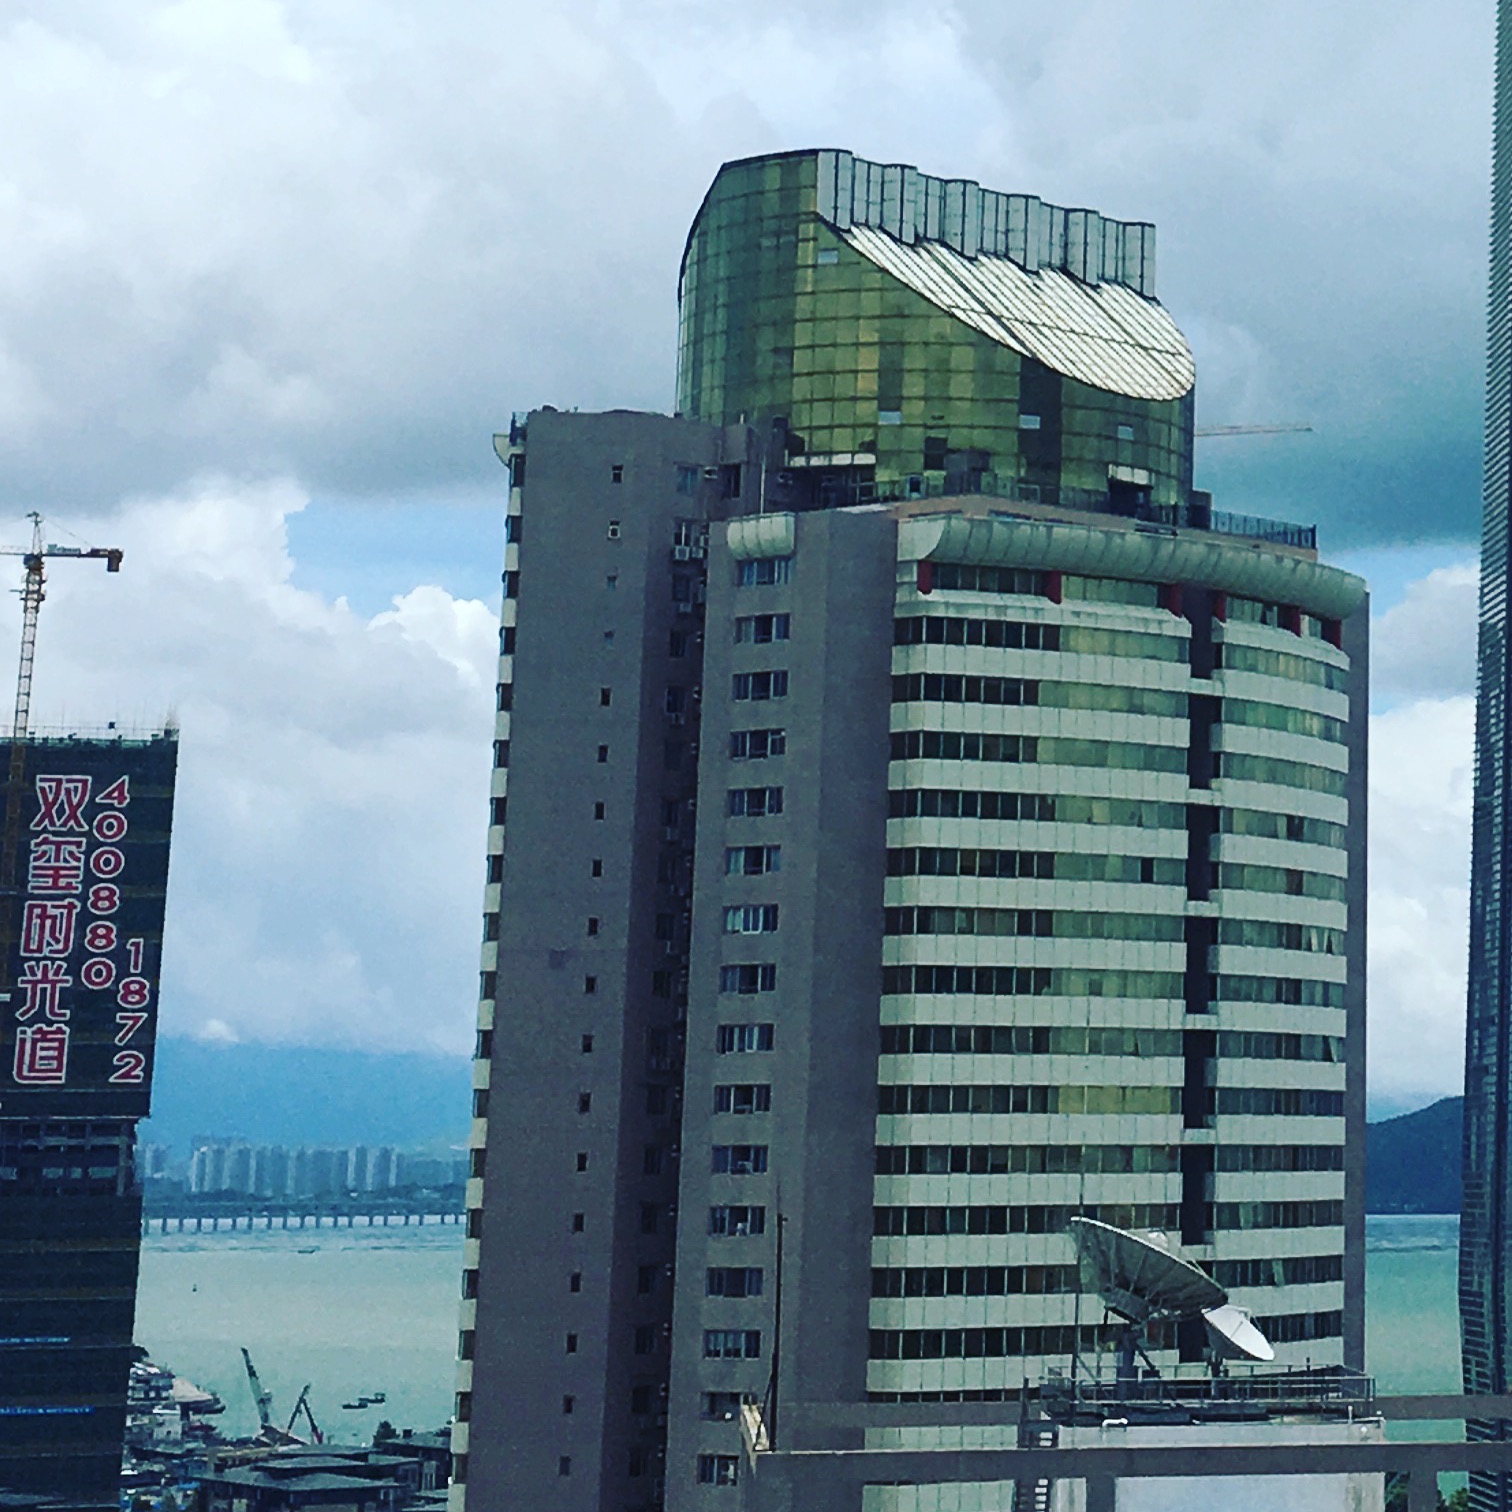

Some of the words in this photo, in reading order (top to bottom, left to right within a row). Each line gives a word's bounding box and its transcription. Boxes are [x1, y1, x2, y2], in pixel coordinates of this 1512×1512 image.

[13, 774, 92, 1085] 双玺时光道
[81, 774, 131, 990] 400880
[108, 938, 150, 1083] 1872
